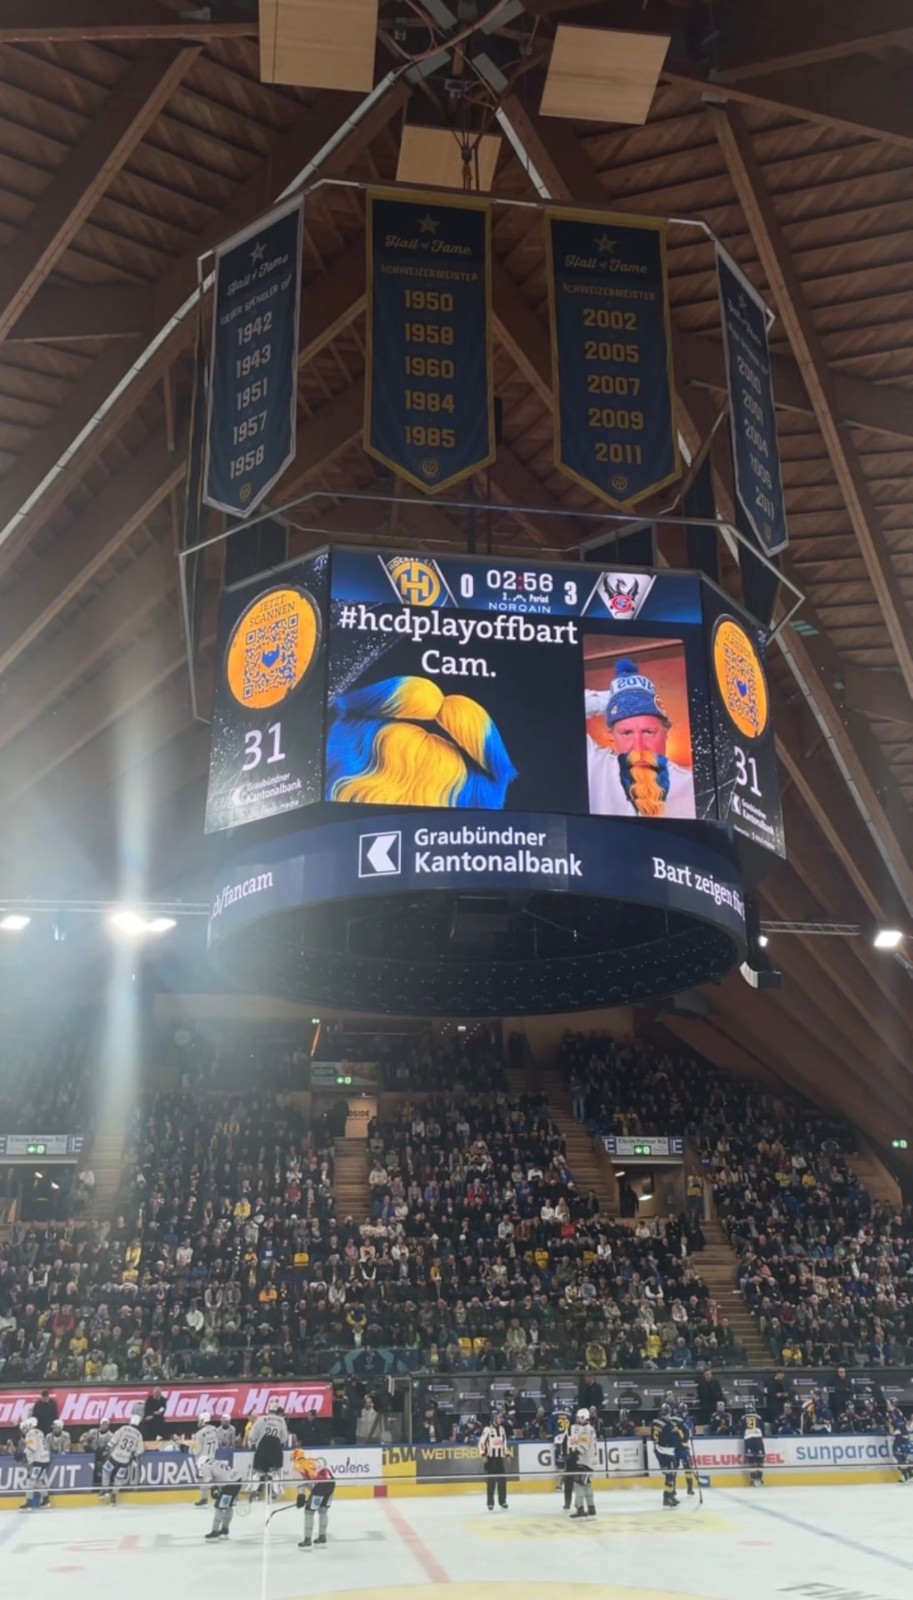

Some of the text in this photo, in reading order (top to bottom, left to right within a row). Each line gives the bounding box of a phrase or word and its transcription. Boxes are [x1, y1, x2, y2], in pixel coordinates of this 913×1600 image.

[385, 235, 418, 250] Hall
[431, 239, 472, 255] Fame
[380, 263, 478, 282] SCHWEIZERMEISTER
[565, 254, 597, 269] Hall
[609, 259, 649, 274] Fame
[404, 289, 453, 312] 1950
[238, 311, 273, 346] 1942
[583, 308, 637, 331] 2002
[404, 322, 454, 345] 1958
[236, 343, 271, 378] 1943
[584, 340, 639, 363] 2005
[404, 356, 455, 379] 1960
[237, 377, 268, 411] 1951
[587, 374, 640, 396] 2007
[404, 389, 456, 414] 1984
[233, 410, 267, 445] 1957
[588, 408, 644, 430] 2009
[404, 425, 455, 448] 1985
[230, 444, 264, 480] 1958
[595, 442, 642, 465] 2011
[460, 573, 474, 598] 0
[487, 569, 553, 592] 02:56
[259, 594, 286, 613] JETZT
[564, 581, 578, 606] 3
[248, 601, 296, 627] SCANNEN
[488, 602, 551, 614] NORQAIN
[339, 604, 579, 645] #hcdplayoffbart
[421, 650, 497, 677] Cam.
[242, 721, 286, 772] 31
[734, 745, 762, 797] 31
[246, 777, 302, 801] Kantonalbank
[414, 826, 546, 847] Graubündner
[414, 850, 583, 877] Kantonalbank
[652, 856, 692, 887] Bart
[694, 874, 733, 906] zeigen
[211, 872, 273, 919] d/fancam
[796, 1439, 890, 1464] sunparad
[330, 1457, 370, 1474] valens
